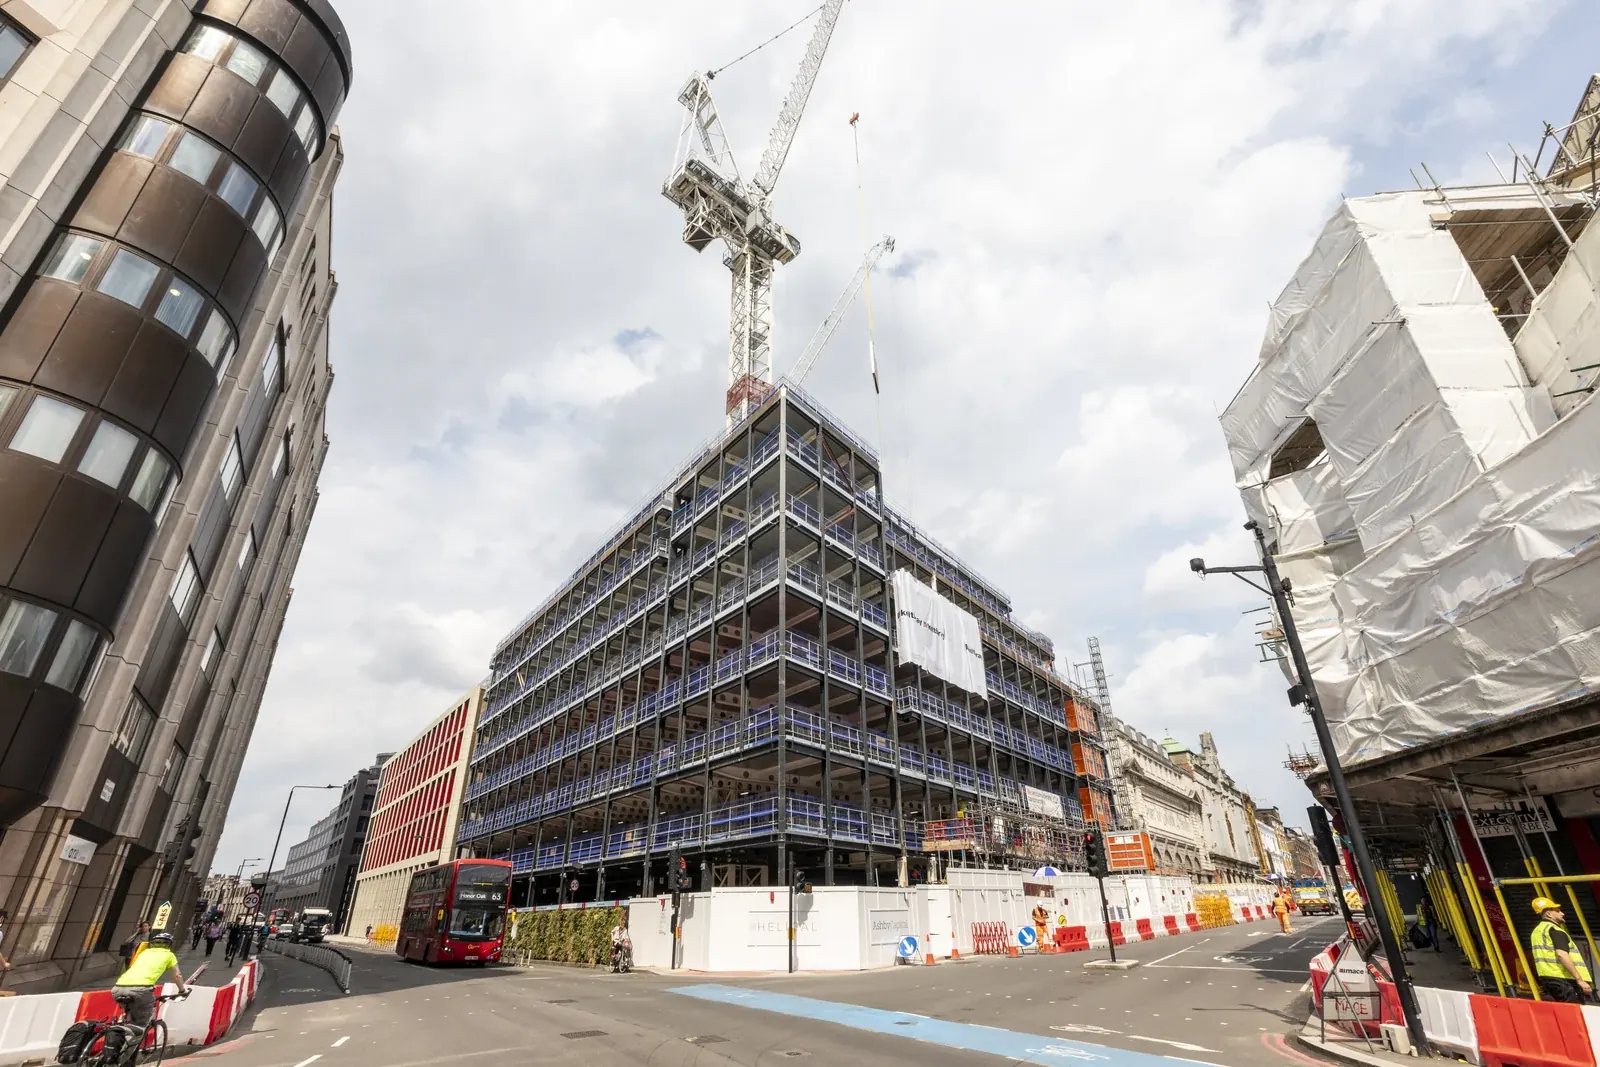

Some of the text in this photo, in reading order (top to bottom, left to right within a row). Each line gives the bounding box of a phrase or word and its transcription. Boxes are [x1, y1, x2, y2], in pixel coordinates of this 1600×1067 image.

[1504, 820, 1551, 833] BRBER
[245, 896, 258, 905] 20
[491, 893, 501, 901] 63
[1335, 1001, 1368, 1015] MACE
